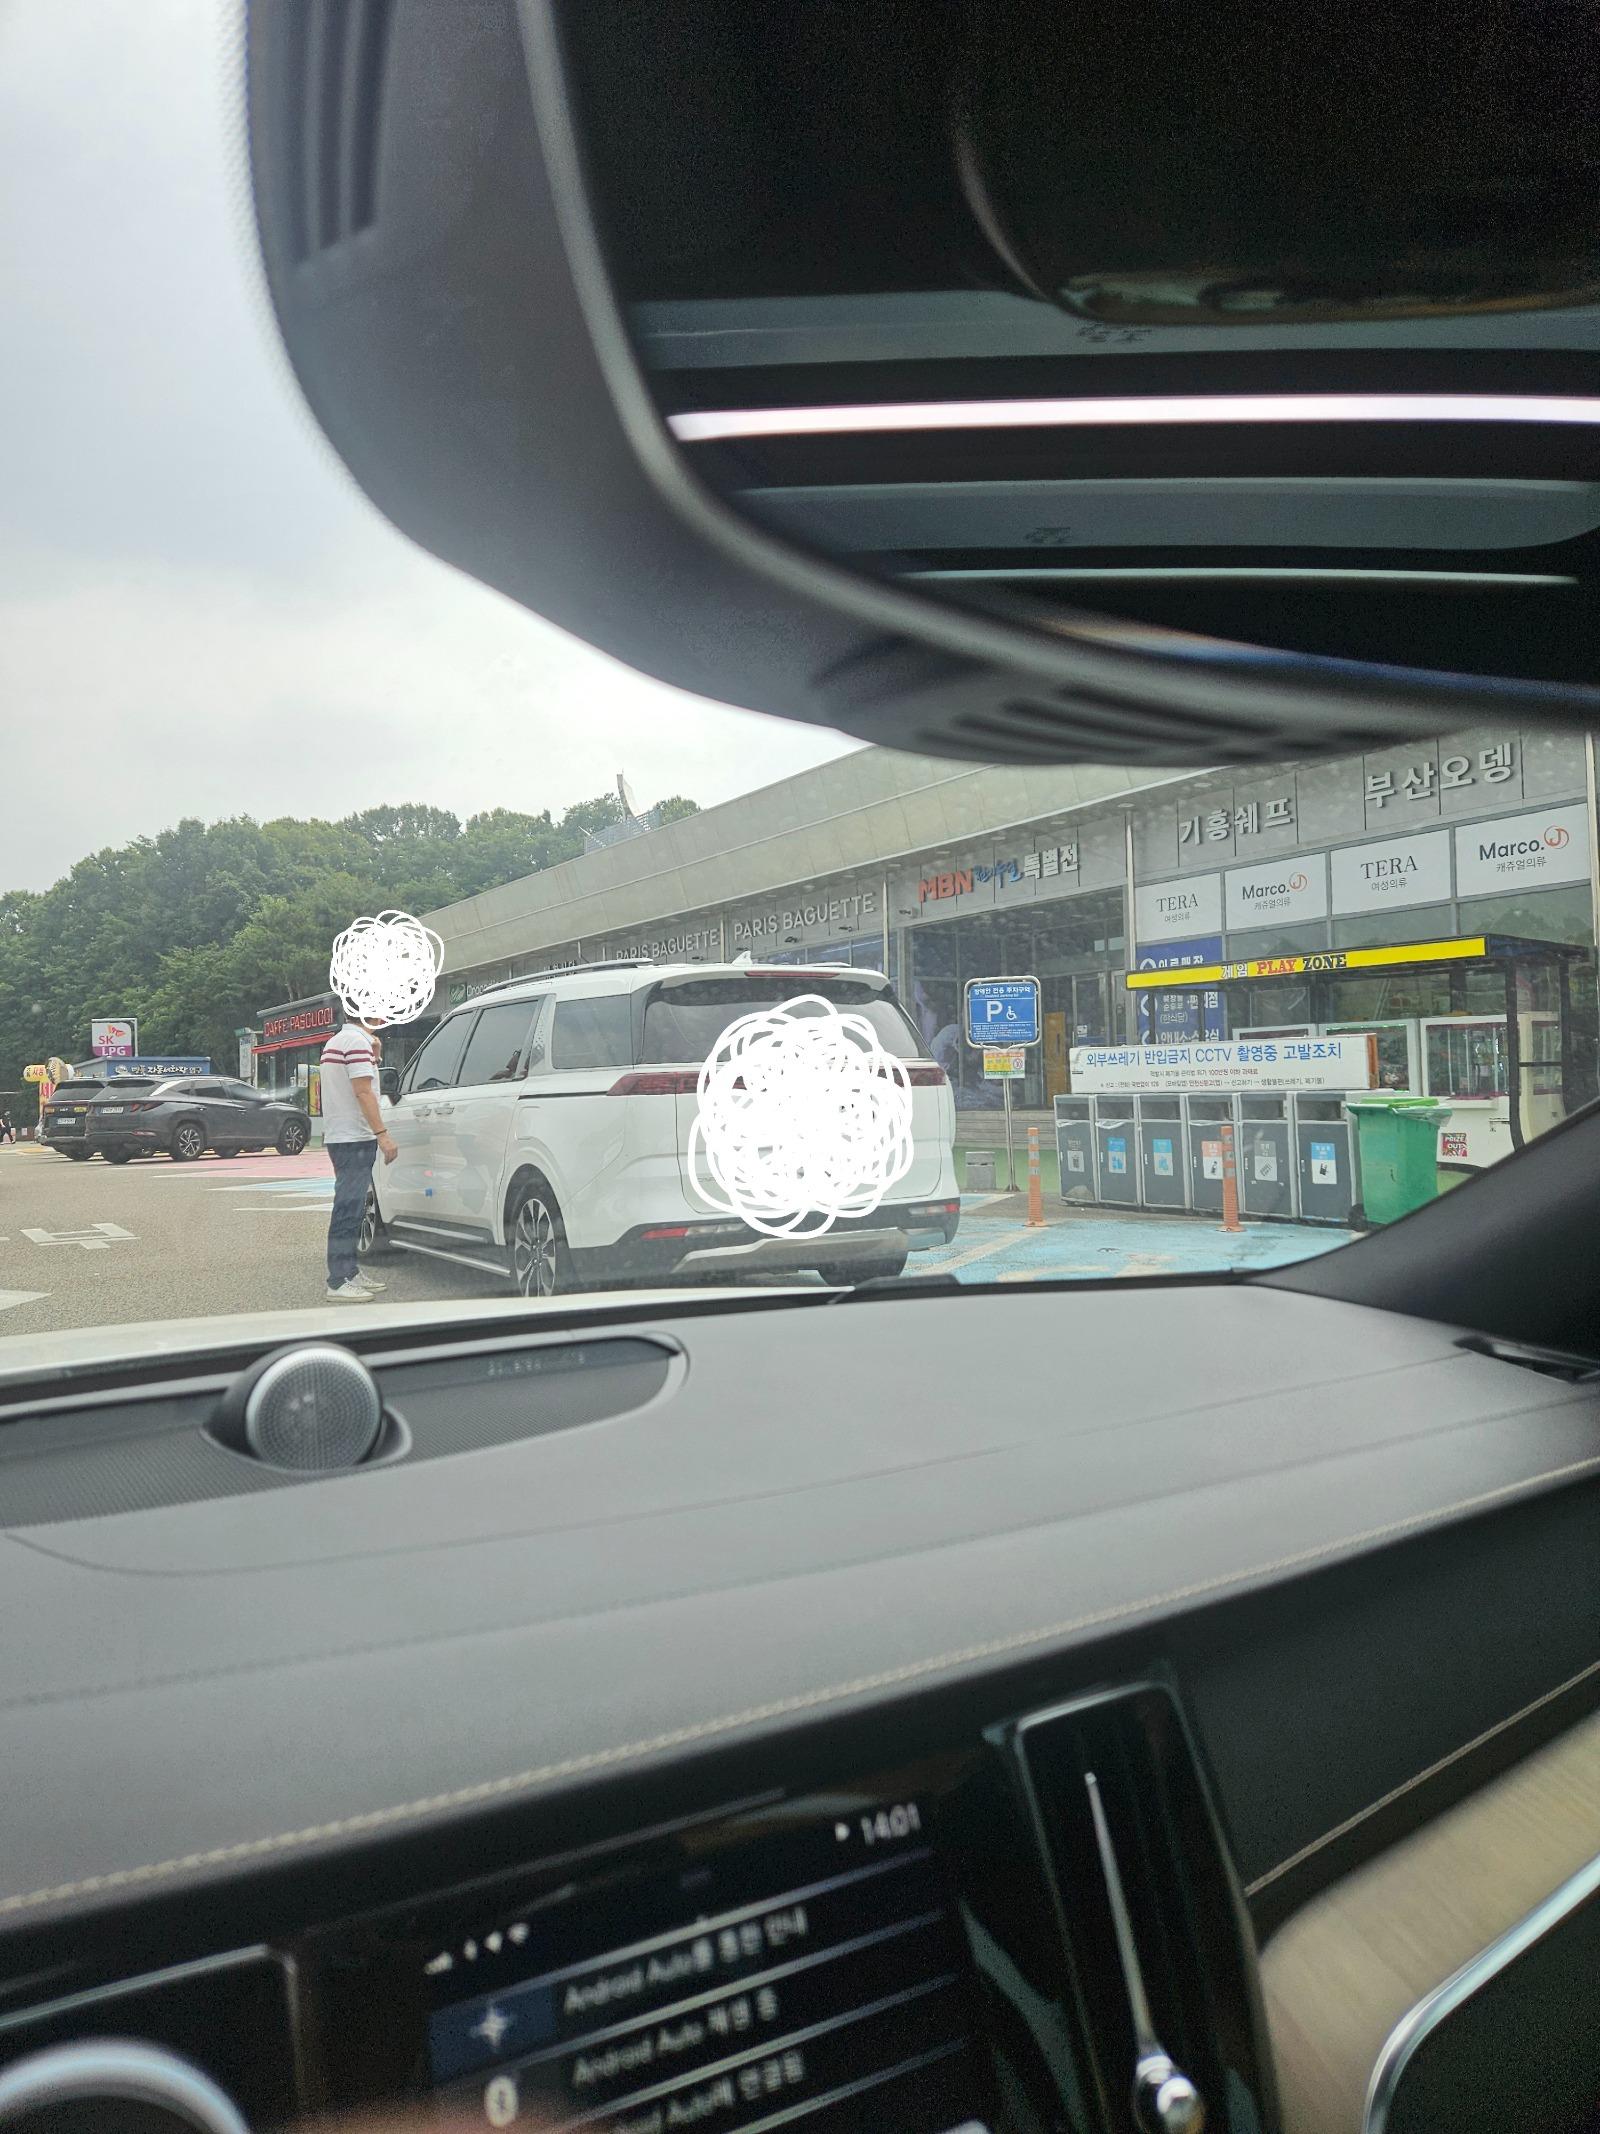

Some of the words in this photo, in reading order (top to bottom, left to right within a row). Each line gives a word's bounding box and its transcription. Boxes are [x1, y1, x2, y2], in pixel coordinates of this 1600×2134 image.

[1365, 742, 1512, 808] 부산오뎅
[1180, 798, 1293, 845] 기흥쉐프
[1479, 839, 1544, 860] Marco.
[918, 868, 974, 903] MBN
[1024, 843, 1080, 879] 특별전
[1360, 855, 1418, 879] TERA
[1496, 856, 1547, 873] 캐쥬얼의류
[1242, 882, 1289, 900] Marco.
[1371, 878, 1407, 892] 여성의류
[1156, 893, 1199, 912] TERA
[734, 914, 779, 940] PARIS
[783, 892, 876, 929] BAGUETTE
[1164, 912, 1190, 923] 여성의류
[616, 943, 649, 960] PARIS
[652, 928, 720, 957] BAGUETTE
[1221, 963, 1249, 979] 게임
[1256, 959, 1297, 975] PLAY
[1302, 953, 1347, 971] ZONE
[264, 1018, 287, 1037] CAFFE
[291, 1007, 334, 1030] PASCUCCI
[986, 1000, 1003, 1022] P
[98, 1035, 114, 1045] SK
[101, 1046, 126, 1056] LPG
[1086, 1052, 1140, 1067] 외부쓰레기
[1144, 1048, 1191, 1065] 반입금지
[1195, 1048, 1231, 1063] CCTV
[1237, 1044, 1278, 1062] 촬영중
[1283, 1042, 1341, 1060] 고발조치
